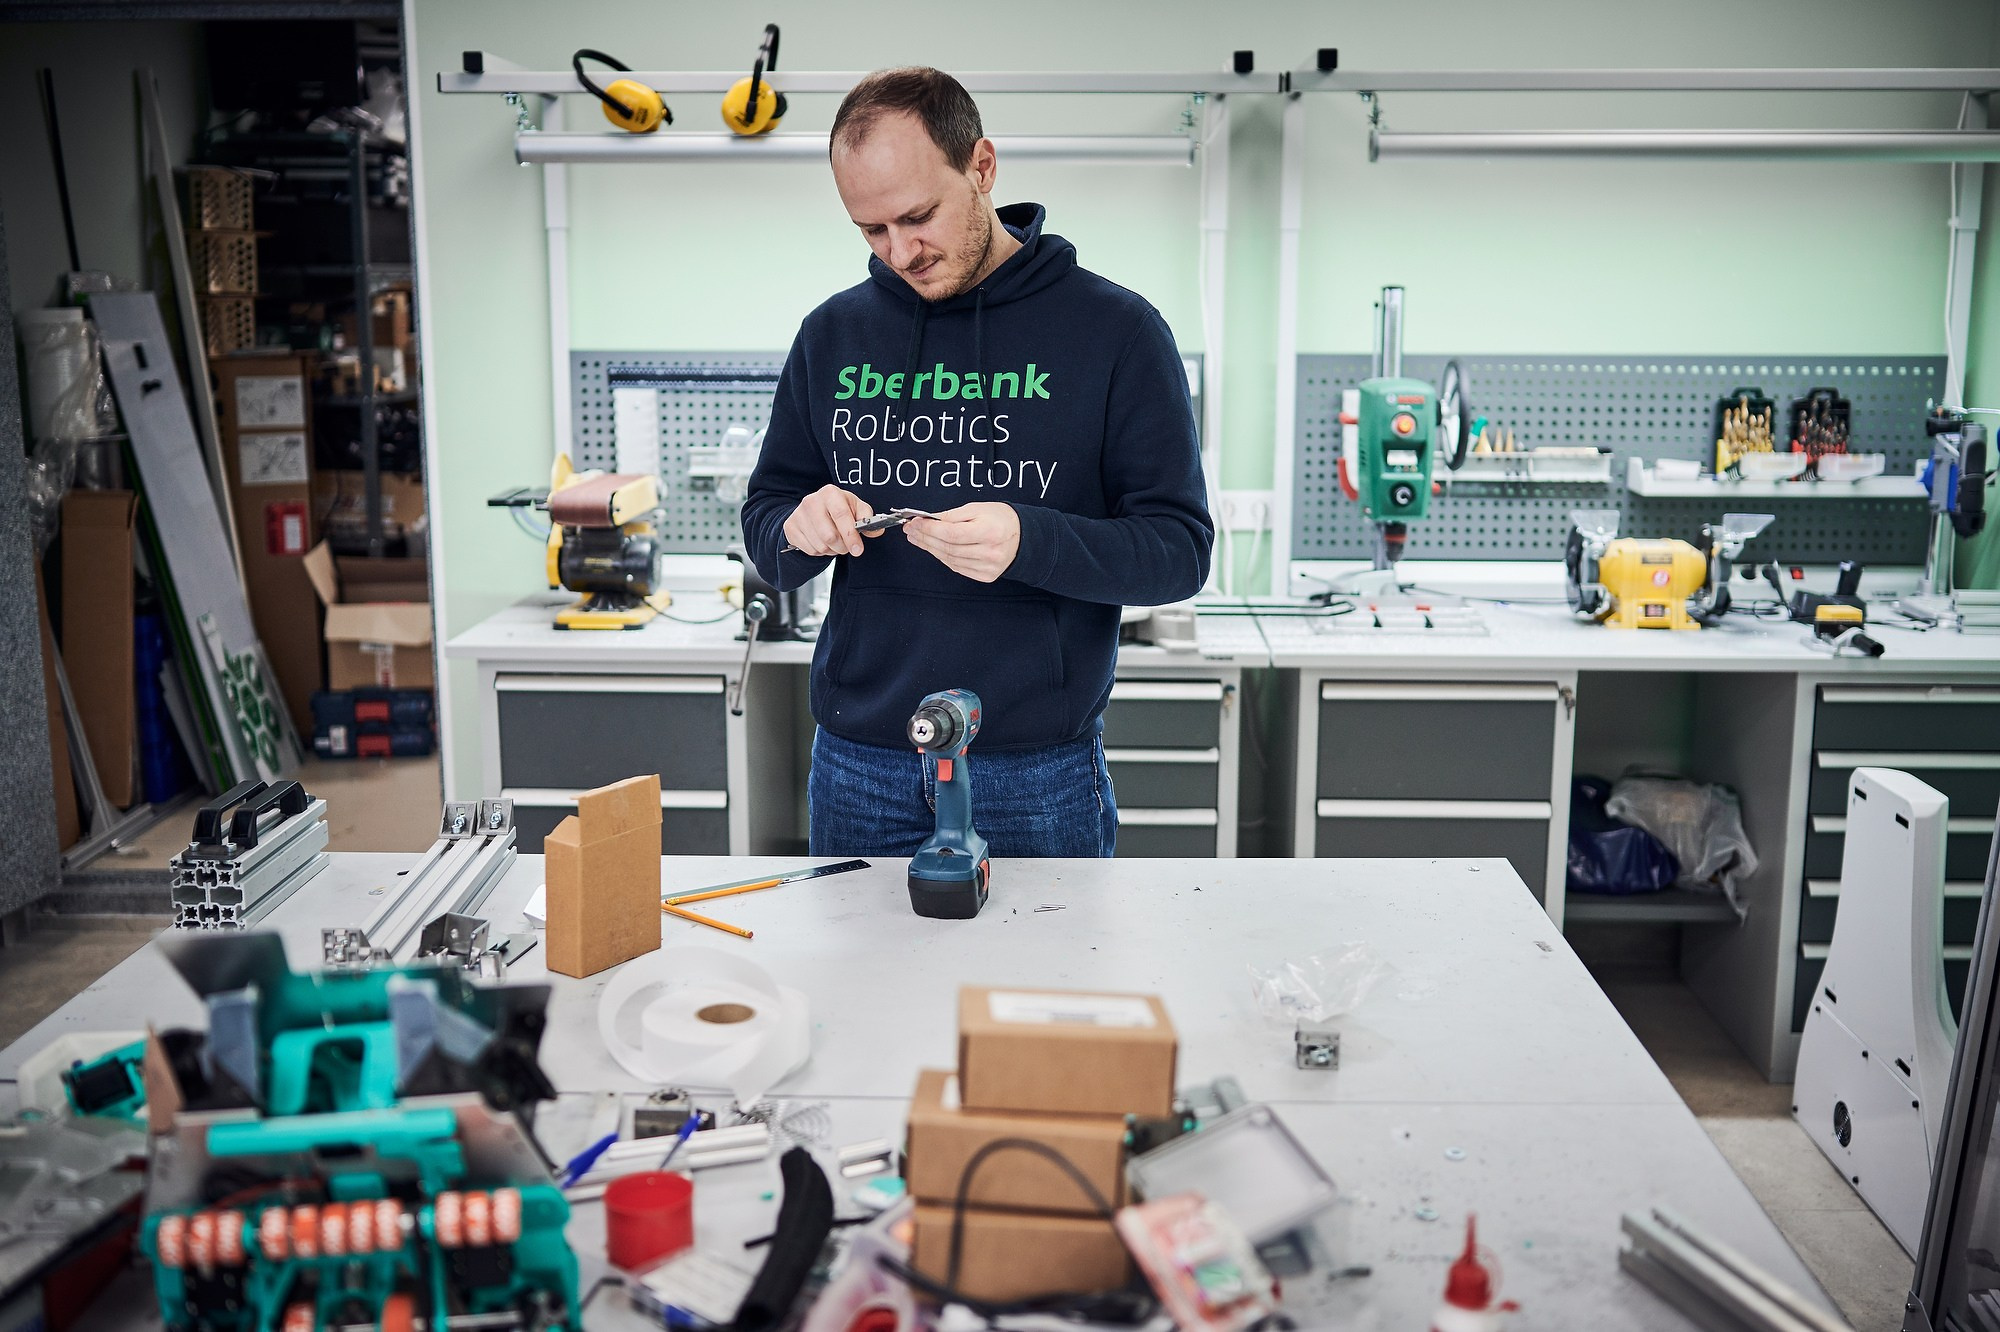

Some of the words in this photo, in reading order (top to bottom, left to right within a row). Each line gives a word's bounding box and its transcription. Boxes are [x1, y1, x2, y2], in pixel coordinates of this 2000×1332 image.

[835, 363, 1050, 399] Sberbank
[832, 406, 1010, 443] Robotics
[833, 449, 1058, 499] Laboratory
